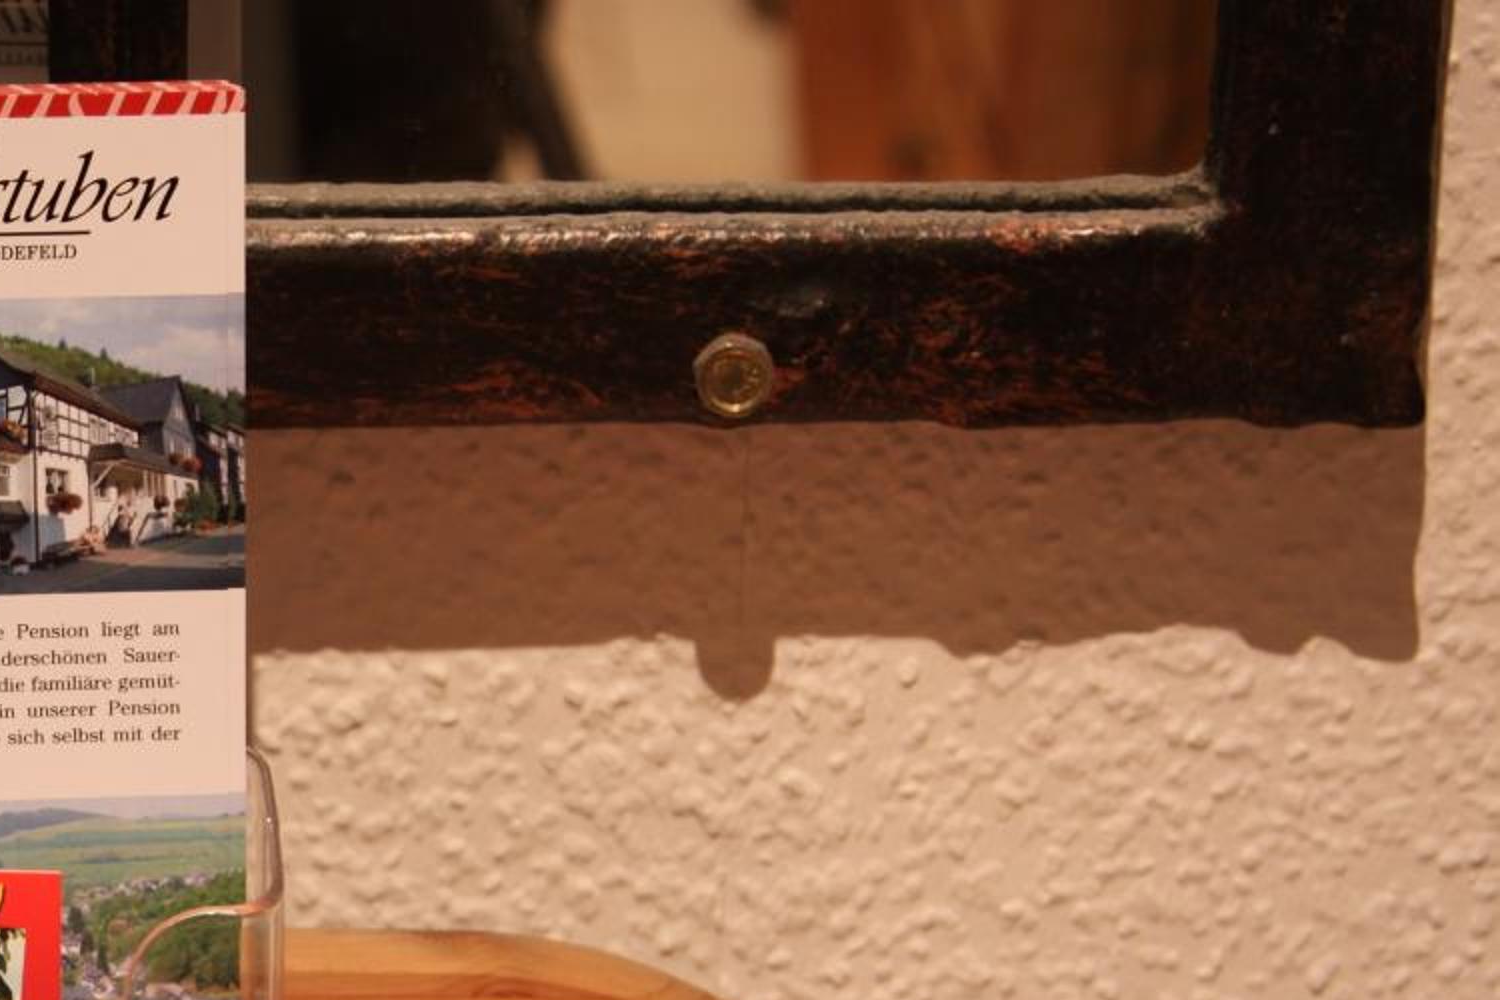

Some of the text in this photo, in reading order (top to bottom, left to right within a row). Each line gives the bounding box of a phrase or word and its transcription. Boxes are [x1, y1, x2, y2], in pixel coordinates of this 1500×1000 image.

[17, 623, 89, 640] Pension
[101, 622, 140, 640] liegt
[152, 623, 180, 637] am
[123, 648, 181, 664] Sauer-
[31, 674, 112, 692] familiäre
[118, 675, 181, 692] gemüt-
[0, 704, 16, 720] in
[27, 704, 97, 718] unserer
[108, 699, 181, 716] Pension
[7, 728, 45, 745] sich
[51, 726, 105, 744] selbst
[113, 726, 142, 742] mit
[151, 726, 181, 741] der
